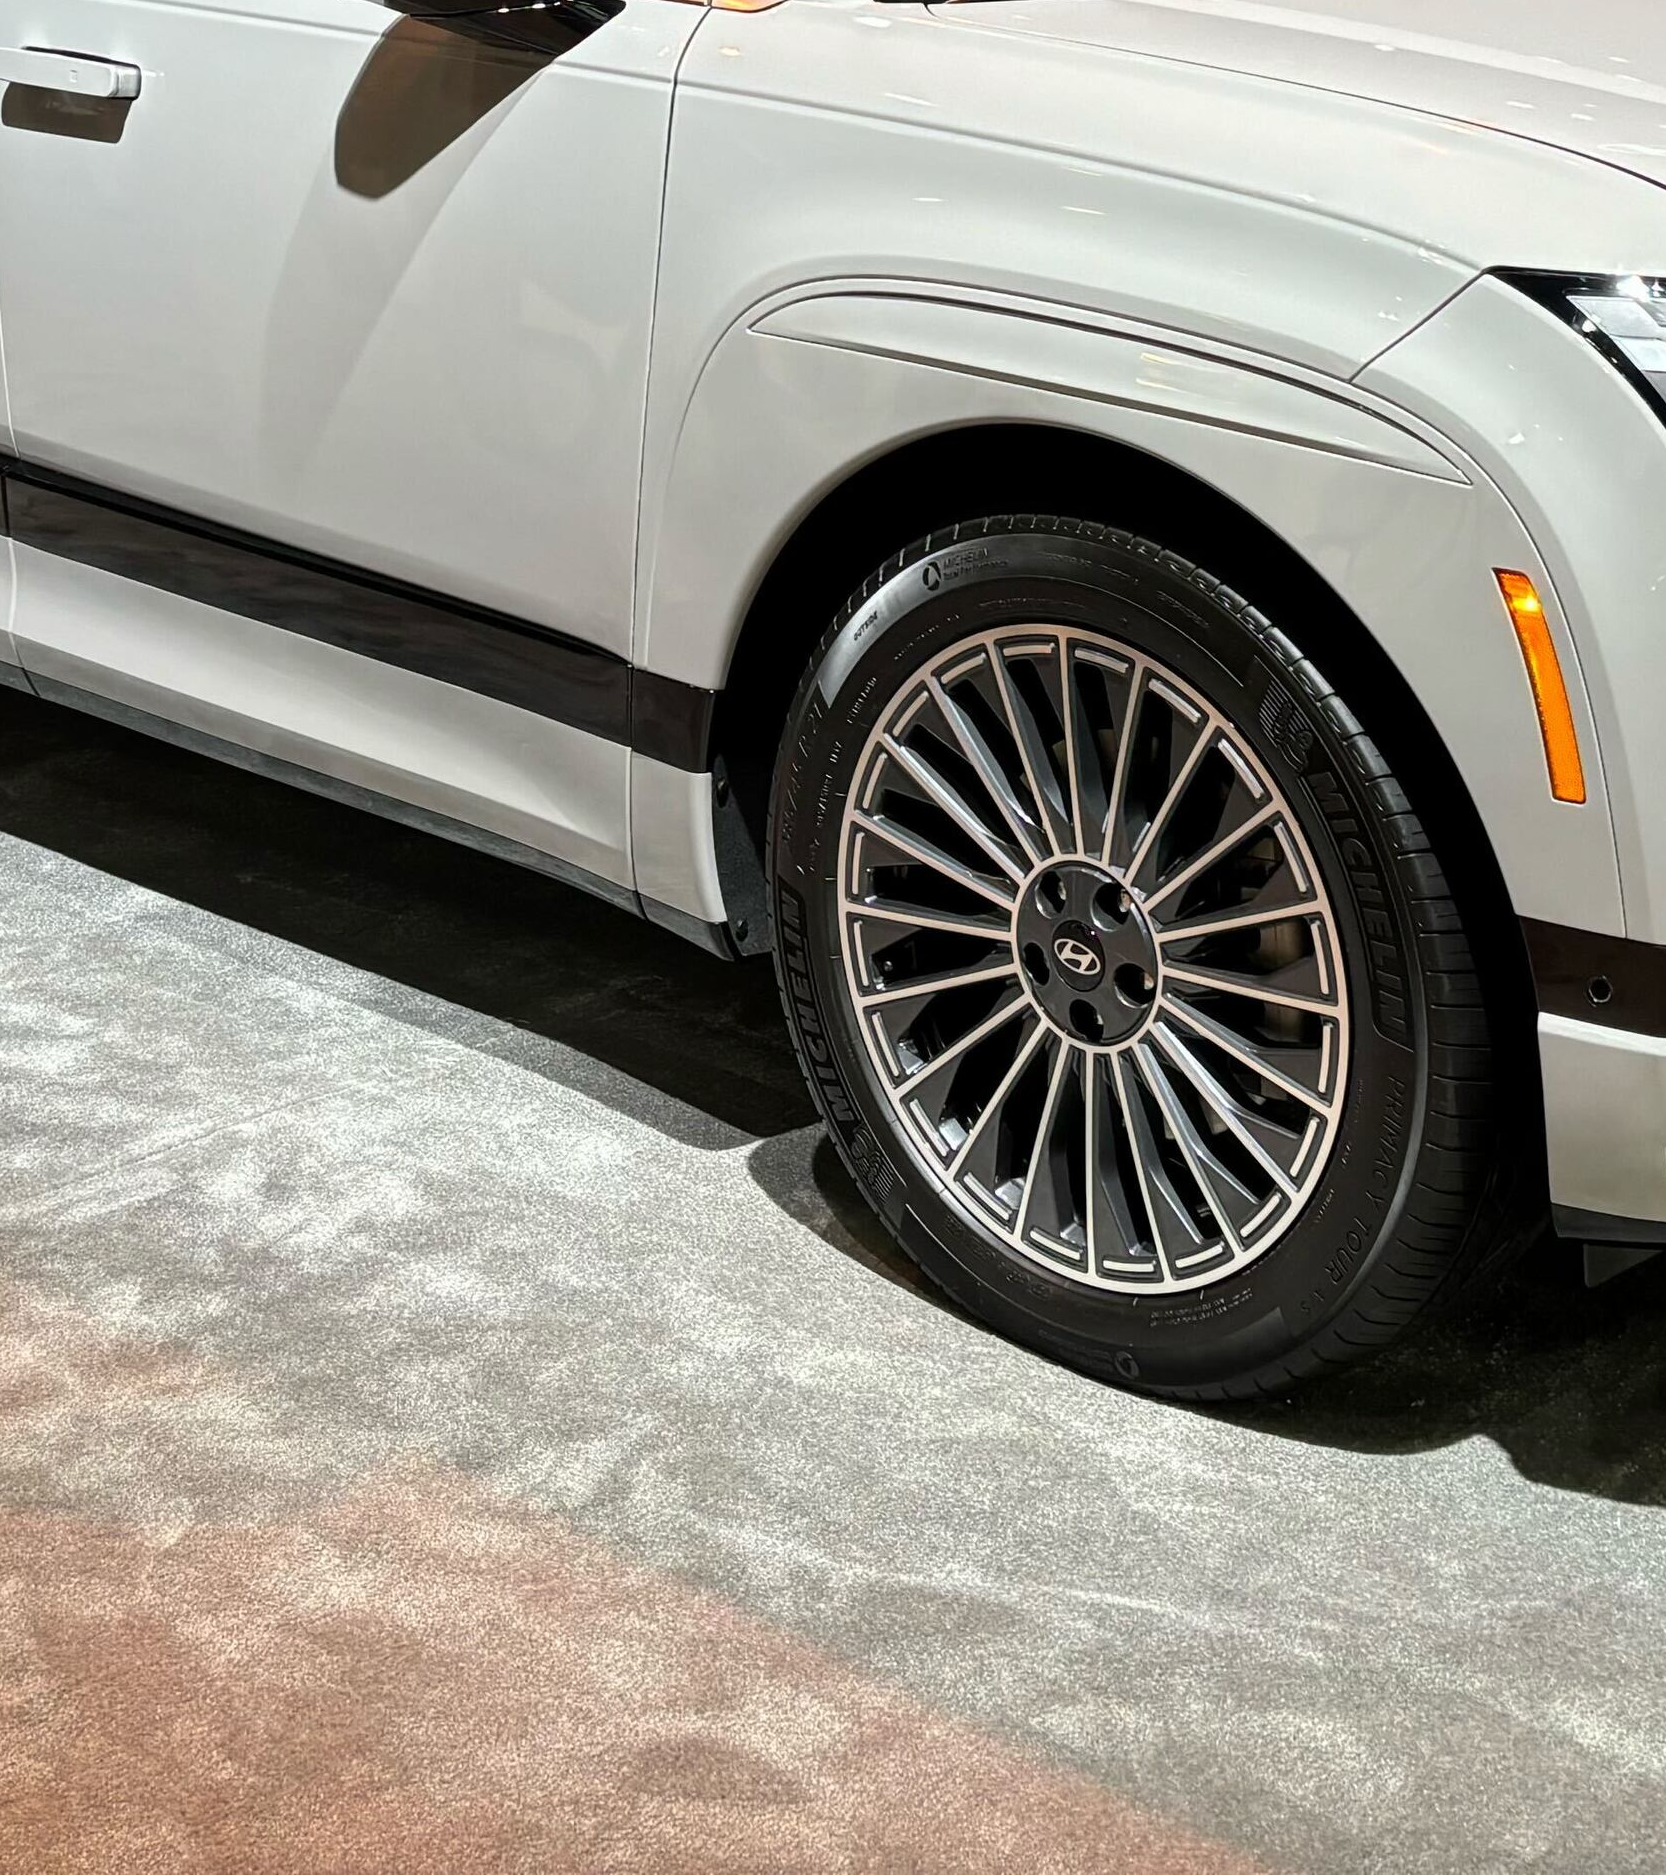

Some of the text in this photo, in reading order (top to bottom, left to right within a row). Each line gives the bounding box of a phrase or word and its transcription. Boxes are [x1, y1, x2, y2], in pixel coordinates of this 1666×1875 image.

[1306, 771, 1406, 1031] MICHELIN
[779, 889, 855, 1123] MICHELIN
[1365, 1076, 1406, 1207] PRIMACY
[1324, 1217, 1371, 1285] TOUR
